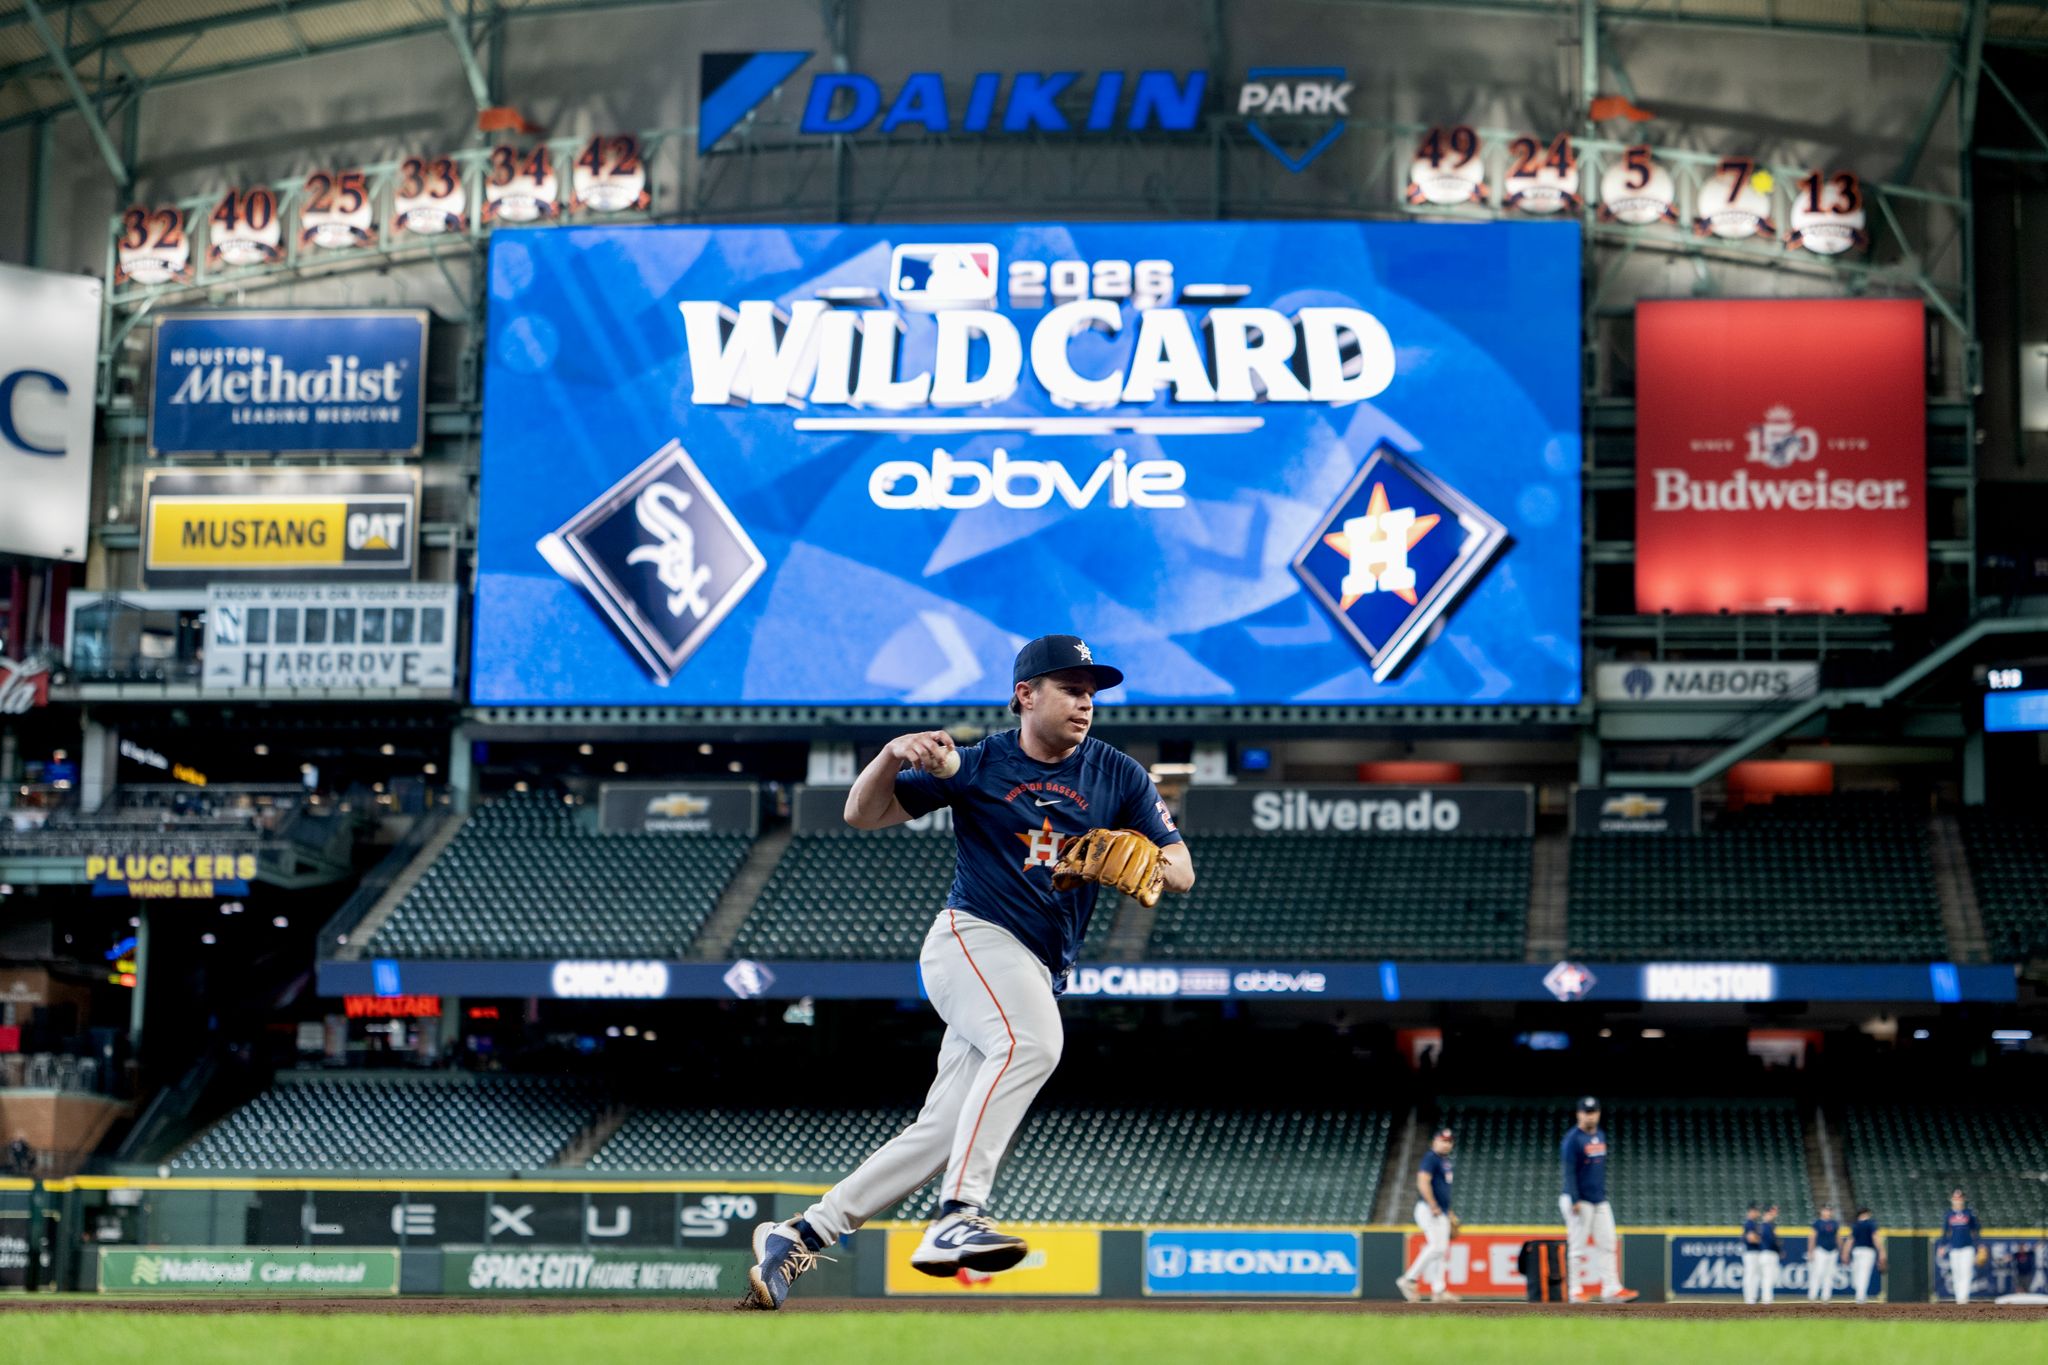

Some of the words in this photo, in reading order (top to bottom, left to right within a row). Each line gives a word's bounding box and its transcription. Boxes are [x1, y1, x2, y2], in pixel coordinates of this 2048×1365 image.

[800, 71, 1206, 133] DAIKIN
[1239, 82, 1354, 114] PARK
[487, 144, 551, 187] 34
[575, 133, 640, 177] 42
[1415, 126, 1481, 169] 49
[1506, 131, 1576, 178] 24
[397, 154, 458, 200] 33
[1623, 145, 1652, 191] 5
[1717, 156, 1753, 204] 7
[211, 186, 276, 231] 40
[302, 168, 366, 214] 25
[1799, 168, 1862, 214] 13
[119, 205, 183, 250] 32
[1008, 259, 1174, 302] 2026
[170, 347, 265, 365] HOUSTON
[678, 301, 1022, 405] WILD
[1030, 300, 1396, 405] CARD
[169, 355, 401, 404] Methodist
[232, 407, 308, 424] LEADING
[315, 406, 400, 423] MEDICINE
[869, 448, 1187, 508] abbvie
[182, 520, 327, 547] MUSTANG
[347, 513, 404, 550] CAT
[244, 652, 421, 686] HARGROVE
[1663, 670, 1790, 694] NABORS
[1046, 782, 1089, 811] BASEBALL
[1252, 791, 1460, 830] Silverado
[86, 855, 257, 881] PLUCKERS
[128, 881, 177, 898] WING
[179, 881, 214, 898] BAR
[553, 960, 668, 997] CHICAGO
[1234, 970, 1326, 993] abbvie
[1647, 962, 1772, 1000] HOUSTON
[701, 1196, 757, 1220] 370
[160, 1257, 254, 1283] National
[260, 1263, 297, 1283] Car
[298, 1262, 366, 1283] Rental
[638, 1262, 722, 1290] NETWORK
[1191, 1250, 1356, 1275] HONDA
